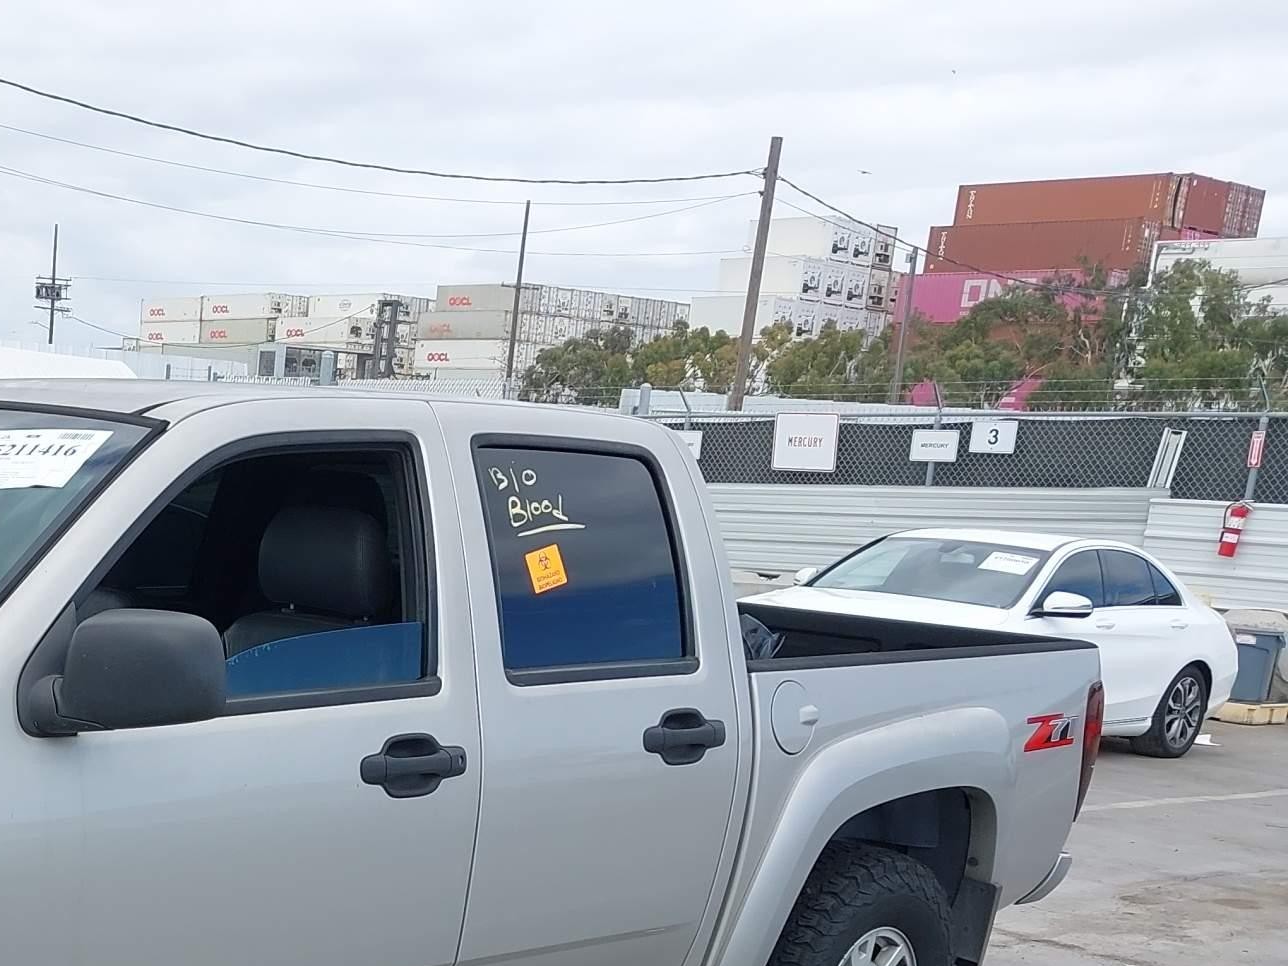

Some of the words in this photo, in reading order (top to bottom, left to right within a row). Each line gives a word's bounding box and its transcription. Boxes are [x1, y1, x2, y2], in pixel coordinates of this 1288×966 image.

[448, 296, 473, 306] OOCL
[149, 308, 166, 317] OOCL
[212, 304, 230, 314] OOCL
[148, 332, 164, 341] OOCL
[210, 329, 228, 339] OOCL
[286, 328, 305, 338] OOCL
[427, 352, 450, 362] OOCL
[787, 435, 824, 448] MERCURY
[987, 428, 1000, 446] 3
[507, 494, 569, 528] Blood
[1023, 712, 1080, 753] Z71
